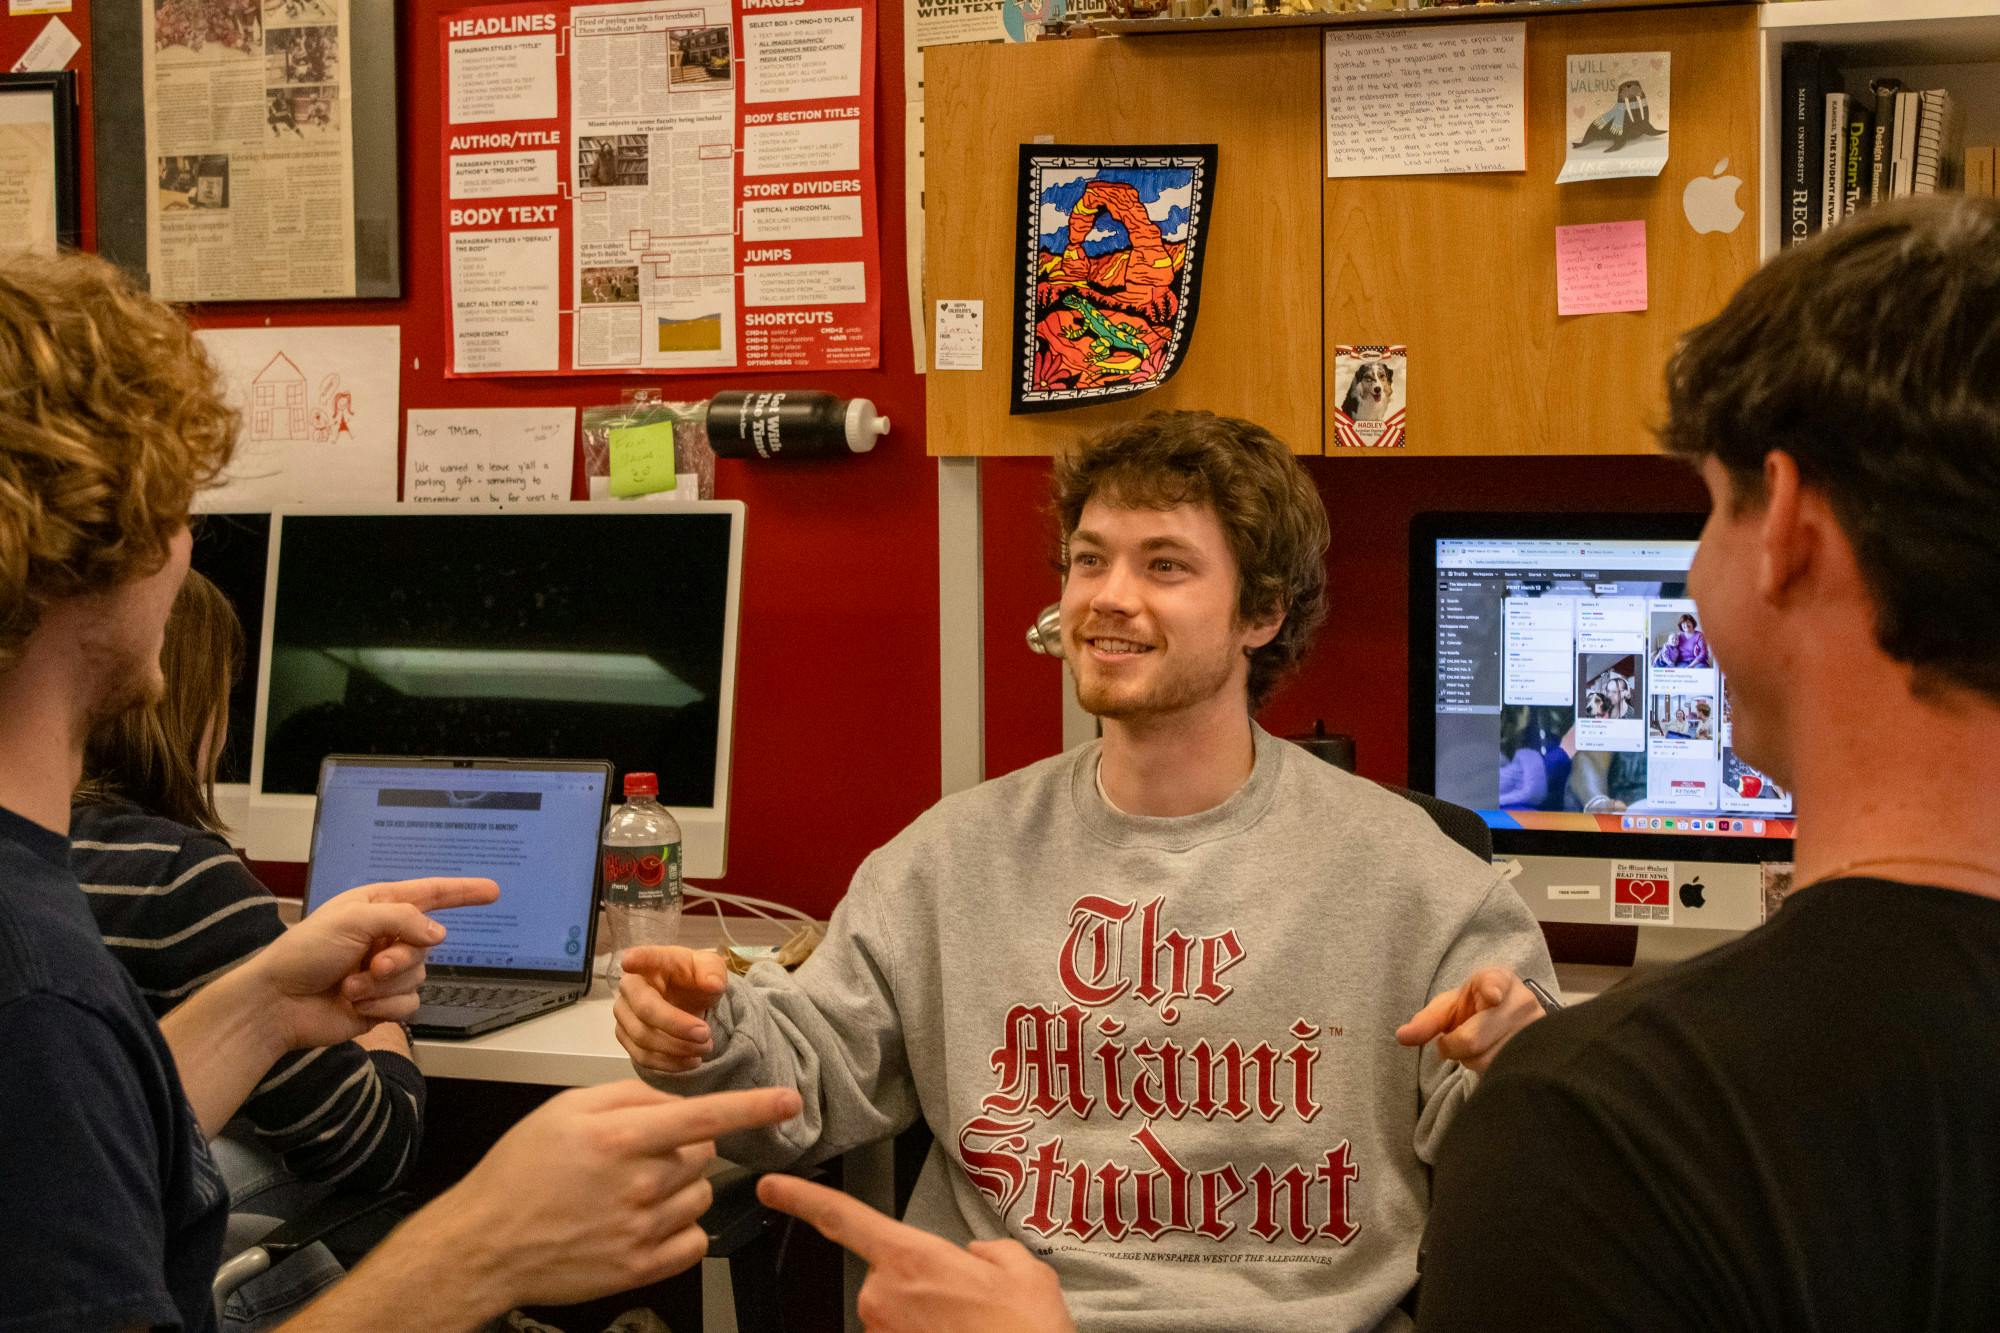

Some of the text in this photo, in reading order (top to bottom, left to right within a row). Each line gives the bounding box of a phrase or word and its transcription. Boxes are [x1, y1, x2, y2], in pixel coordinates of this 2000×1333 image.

[917, 6, 959, 18] WITH
[962, 2, 1005, 13] TEXT
[449, 13, 557, 37] HEADLINES
[1578, 59, 1608, 73] WILL
[1570, 79, 1617, 93] WALRUS
[1798, 88, 1806, 121] MIAMI
[744, 107, 860, 124] BODY SECTION TITLES
[450, 131, 560, 150] AUTHOR/TITLE
[1874, 126, 1885, 161] Design
[1796, 127, 1805, 184] UNIVERSITY
[1828, 152, 1836, 195] STUDENT
[743, 180, 861, 197] STORY DIVIDERS
[450, 205, 558, 226] BODY TEXT
[790, 204, 831, 212] HORIZONTAL
[744, 249, 792, 262] JUMPS
[745, 311, 834, 326] SHORTCUTS
[753, 394, 771, 417] The
[416, 424, 438, 437] Dear
[767, 393, 786, 453] Get With
[414, 460, 430, 474] We
[440, 461, 469, 473] wanted
[476, 463, 485, 472] to
[489, 462, 510, 472] leave
[414, 479, 447, 493] parting
[456, 475, 473, 491] gift
[486, 477, 527, 491] something
[532, 477, 541, 485] to
[611, 883, 629, 891] cherry
[1057, 893, 1247, 1024] The
[980, 1000, 1343, 1124] Miami TM
[958, 1117, 1361, 1248] Student
[1142, 1251, 1201, 1263] NEWSPAPER
[1202, 1253, 1229, 1263] WEST
[1229, 1253, 1244, 1263] OF
[1244, 1254, 1264, 1264] THE
[1264, 1254, 1333, 1266] ALLEGHENIES
